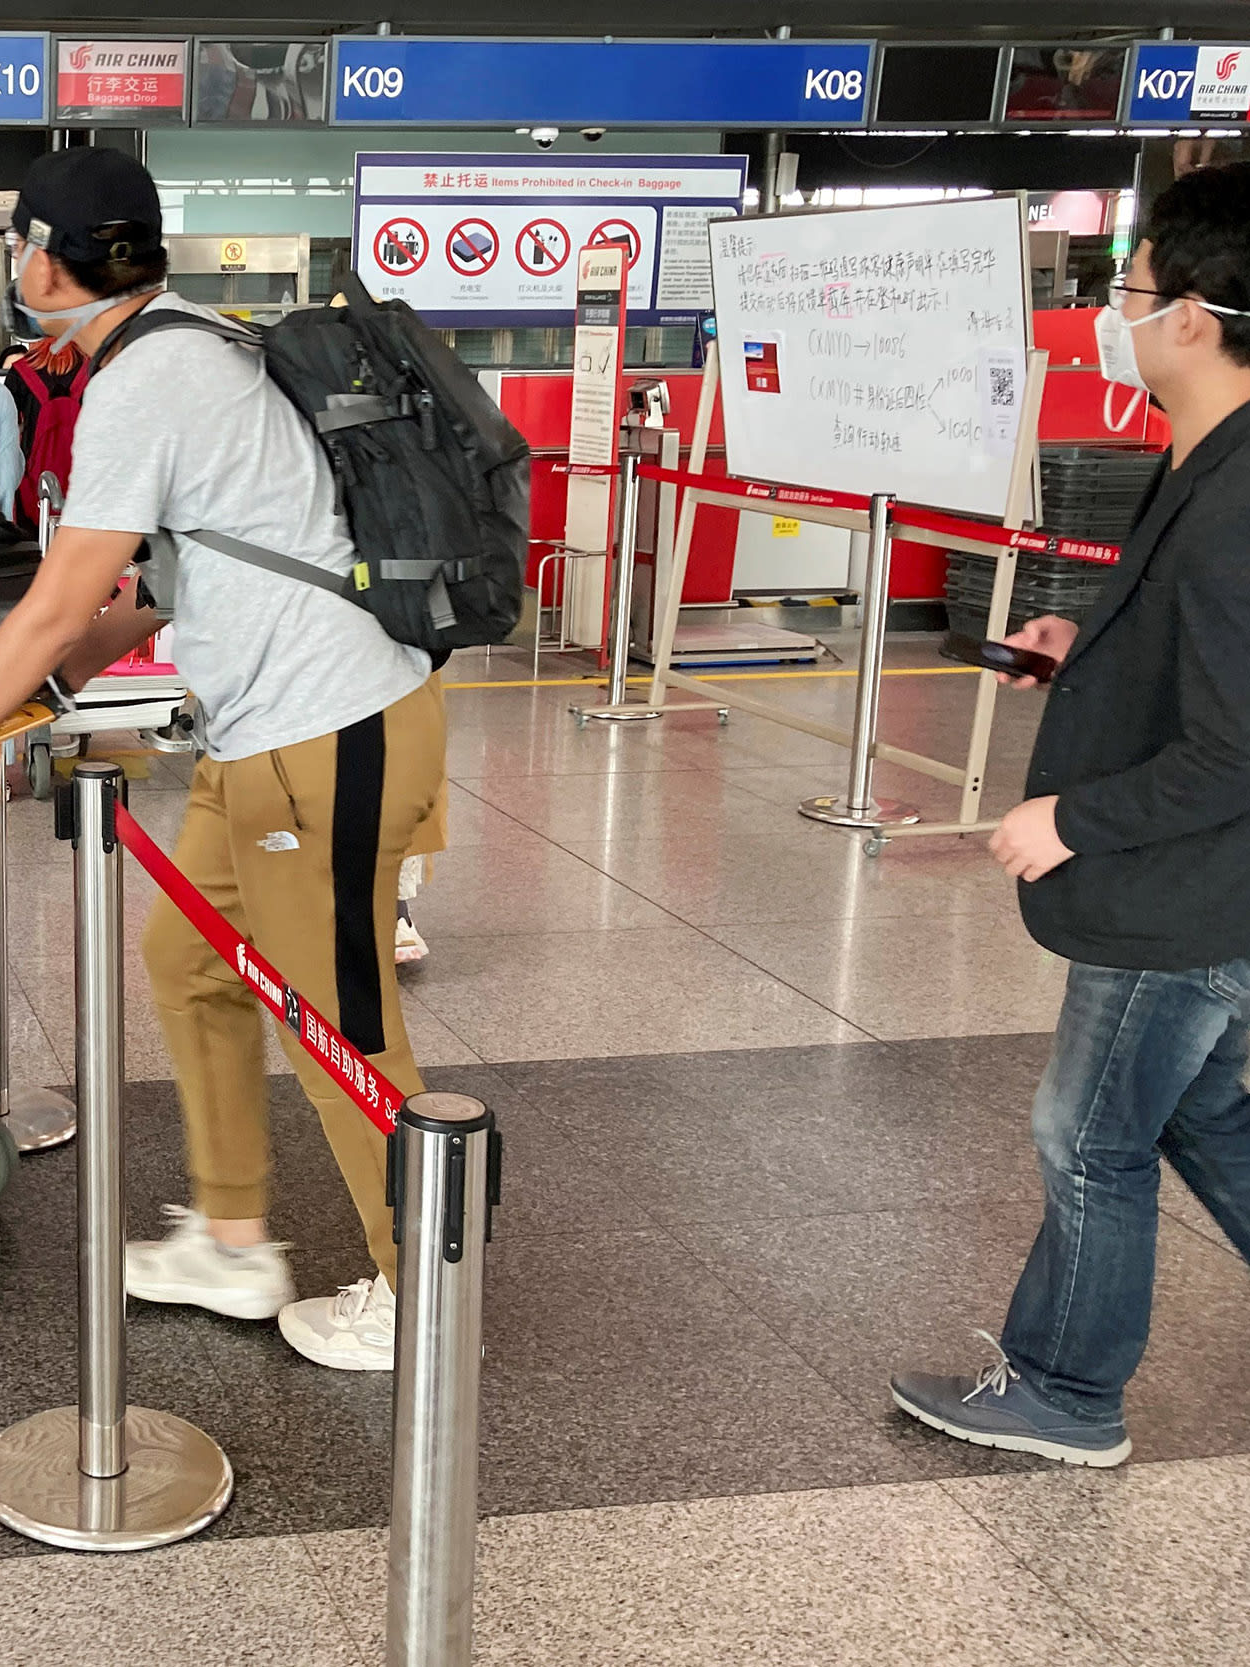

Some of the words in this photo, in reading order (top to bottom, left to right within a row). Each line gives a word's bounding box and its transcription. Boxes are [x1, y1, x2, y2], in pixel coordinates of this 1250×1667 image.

[94, 53, 124, 67] AIR
[126, 53, 178, 68] CHINA
[87, 75, 159, 93] 行李交运
[342, 65, 404, 99] K09
[804, 68, 863, 101] K08
[1137, 68, 1195, 99] K07
[1198, 84, 1216, 94] AIR
[1216, 84, 1248, 95] CHINA
[87, 93, 132, 104] Baggage
[133, 93, 158, 104] Drop
[423, 172, 489, 189] 禁止托运
[491, 177, 520, 188] Items
[522, 177, 575, 188] Prohibited
[576, 178, 587, 188] in
[588, 178, 634, 189] Check-in
[638, 178, 683, 190] Baggage
[247, 957, 260, 986] AIR
[259, 971, 283, 1009] CHINA
[305, 1010, 380, 1109] 国航自助服务
[384, 1096, 399, 1127] Se
